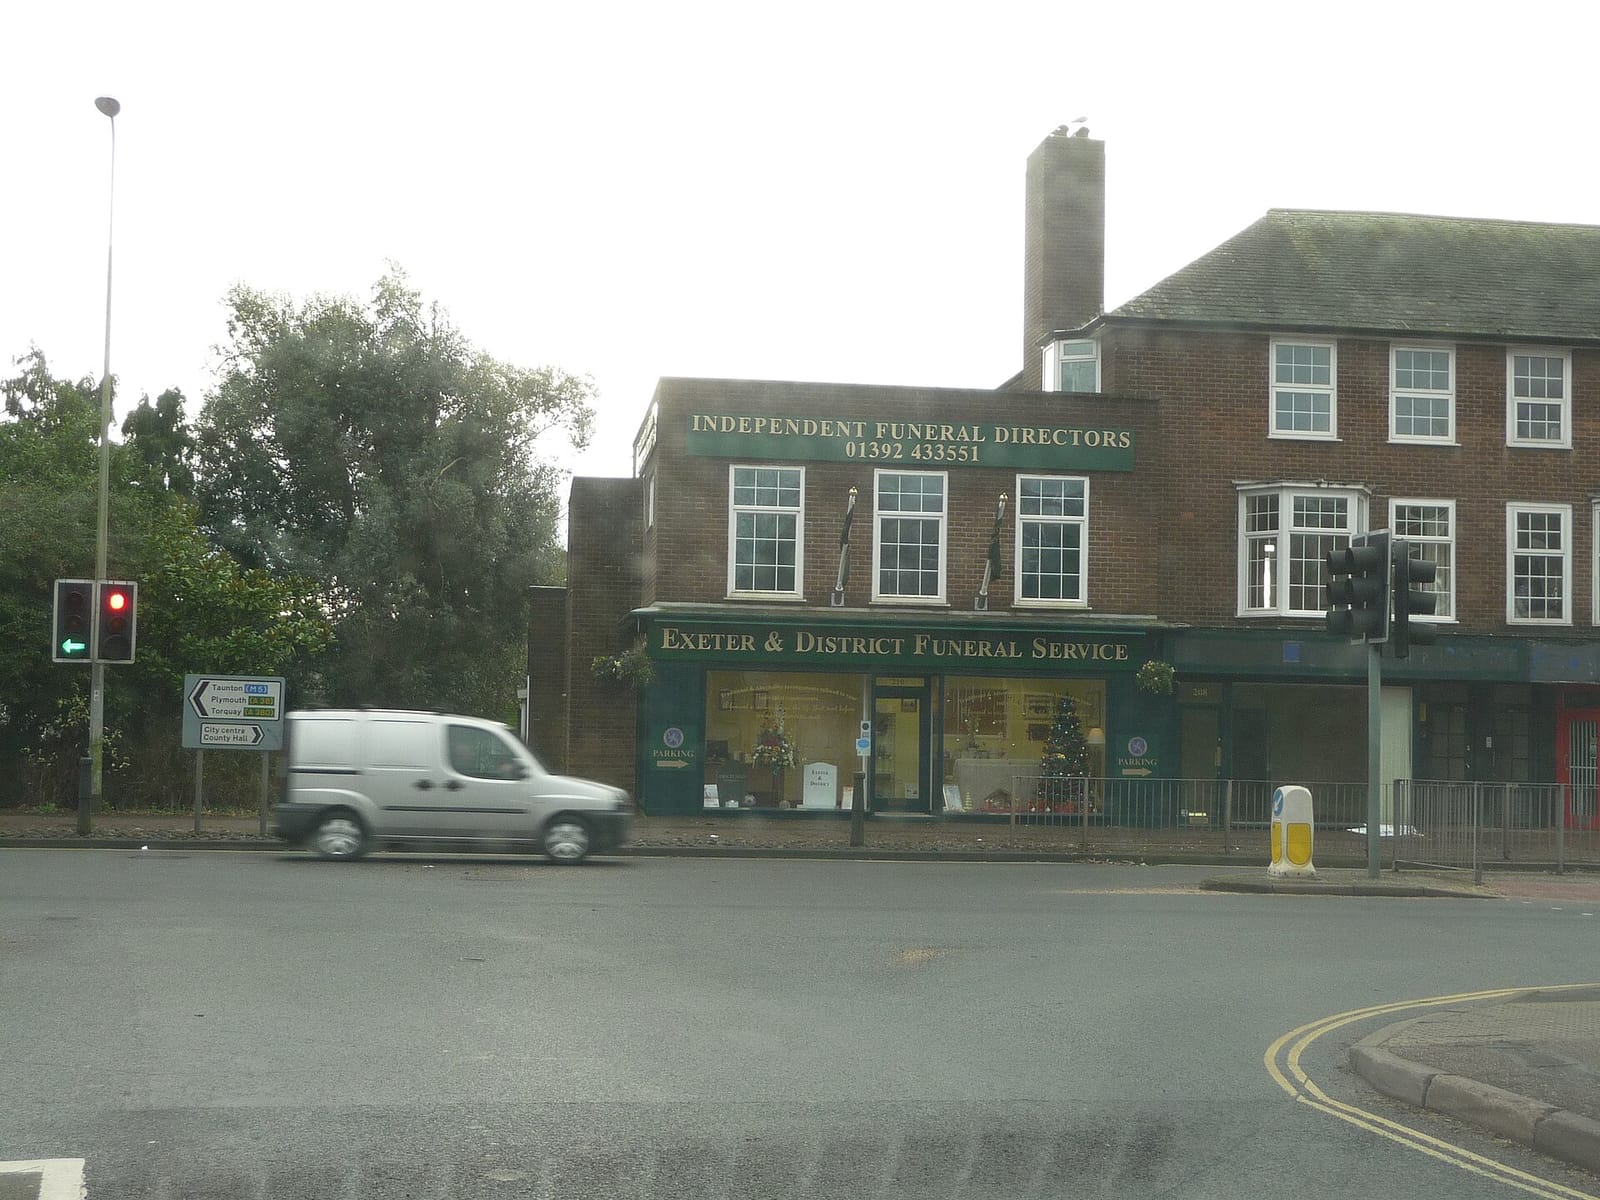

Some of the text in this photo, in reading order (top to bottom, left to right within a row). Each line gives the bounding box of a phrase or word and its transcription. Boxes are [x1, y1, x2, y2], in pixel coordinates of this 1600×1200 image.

[692, 415, 1131, 449] INDEPENDENT FUNERAL DIRECTORS
[846, 441, 979, 462] 01392 433551
[660, 627, 1129, 661] EXETER & DISTRICT FUNERAL SERVICE
[212, 684, 243, 692] Taunton
[211, 695, 247, 705] Plymouth
[211, 707, 242, 716] Torquay
[204, 726, 220, 735] City
[203, 734, 230, 742] County
[653, 749, 695, 758] PARKING
[1118, 758, 1158, 767] PARKING
